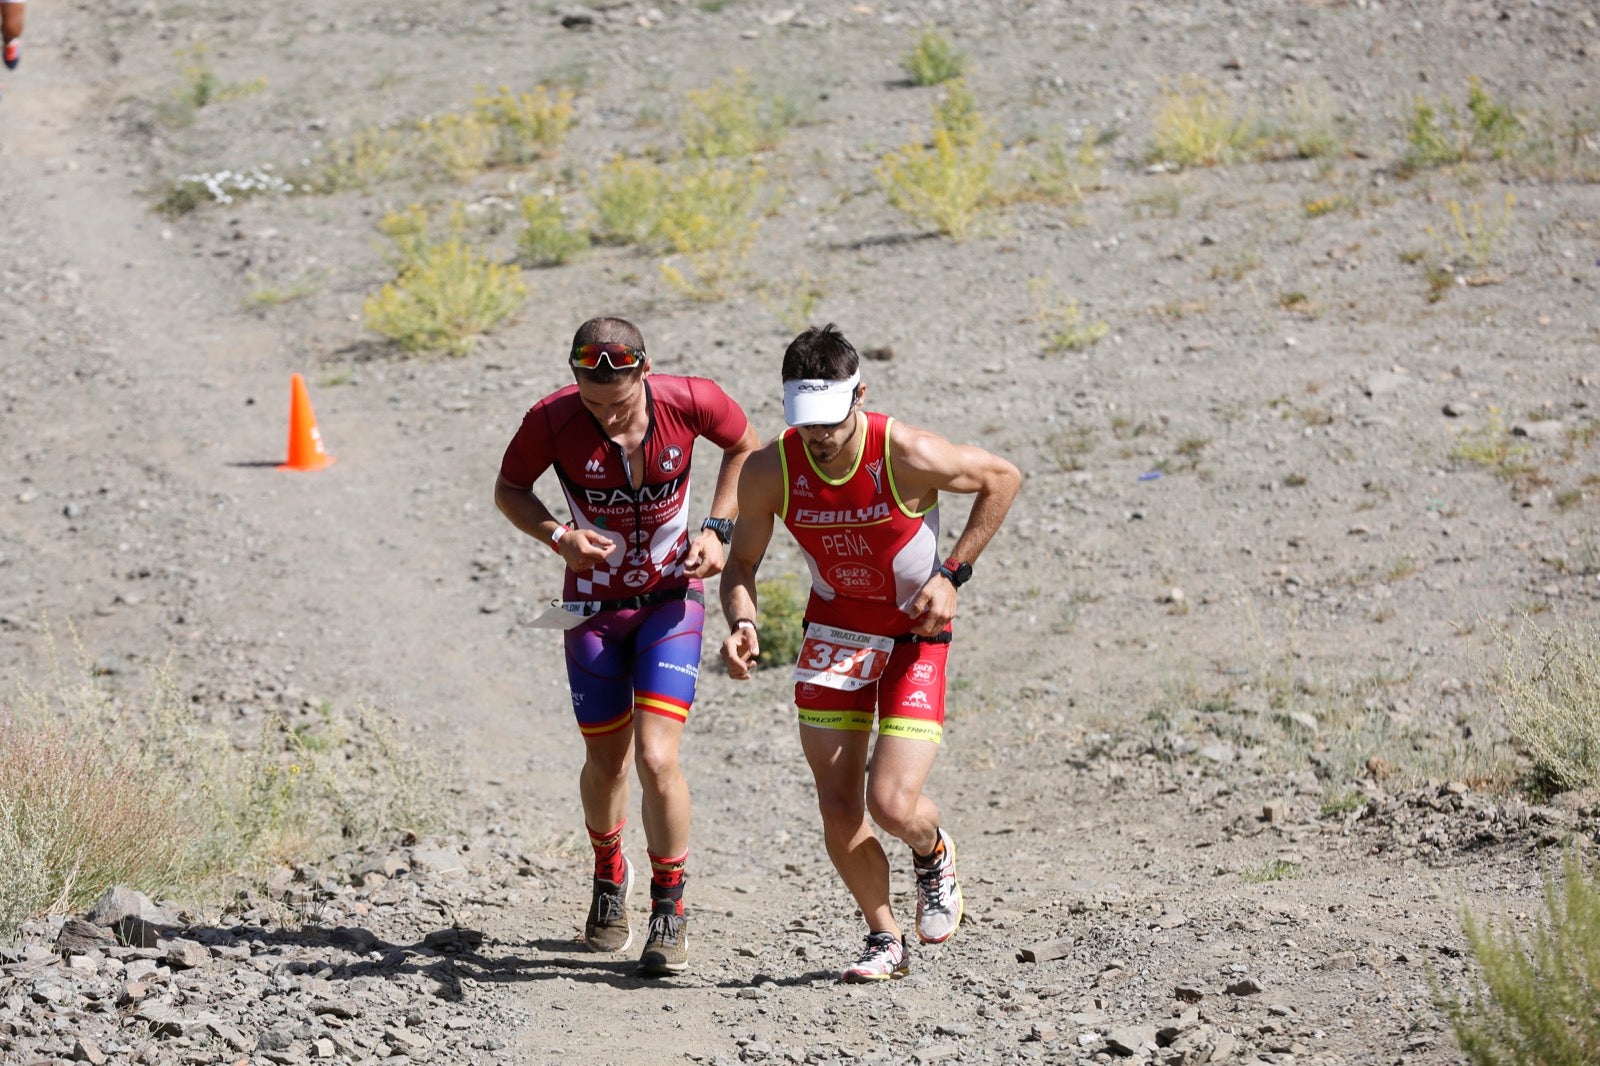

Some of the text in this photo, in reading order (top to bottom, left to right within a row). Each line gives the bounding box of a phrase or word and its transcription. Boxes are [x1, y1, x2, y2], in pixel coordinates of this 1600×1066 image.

[795, 502, 890, 524] ISBILYA
[821, 529, 873, 556] PEÑA
[808, 643, 876, 679] 351
